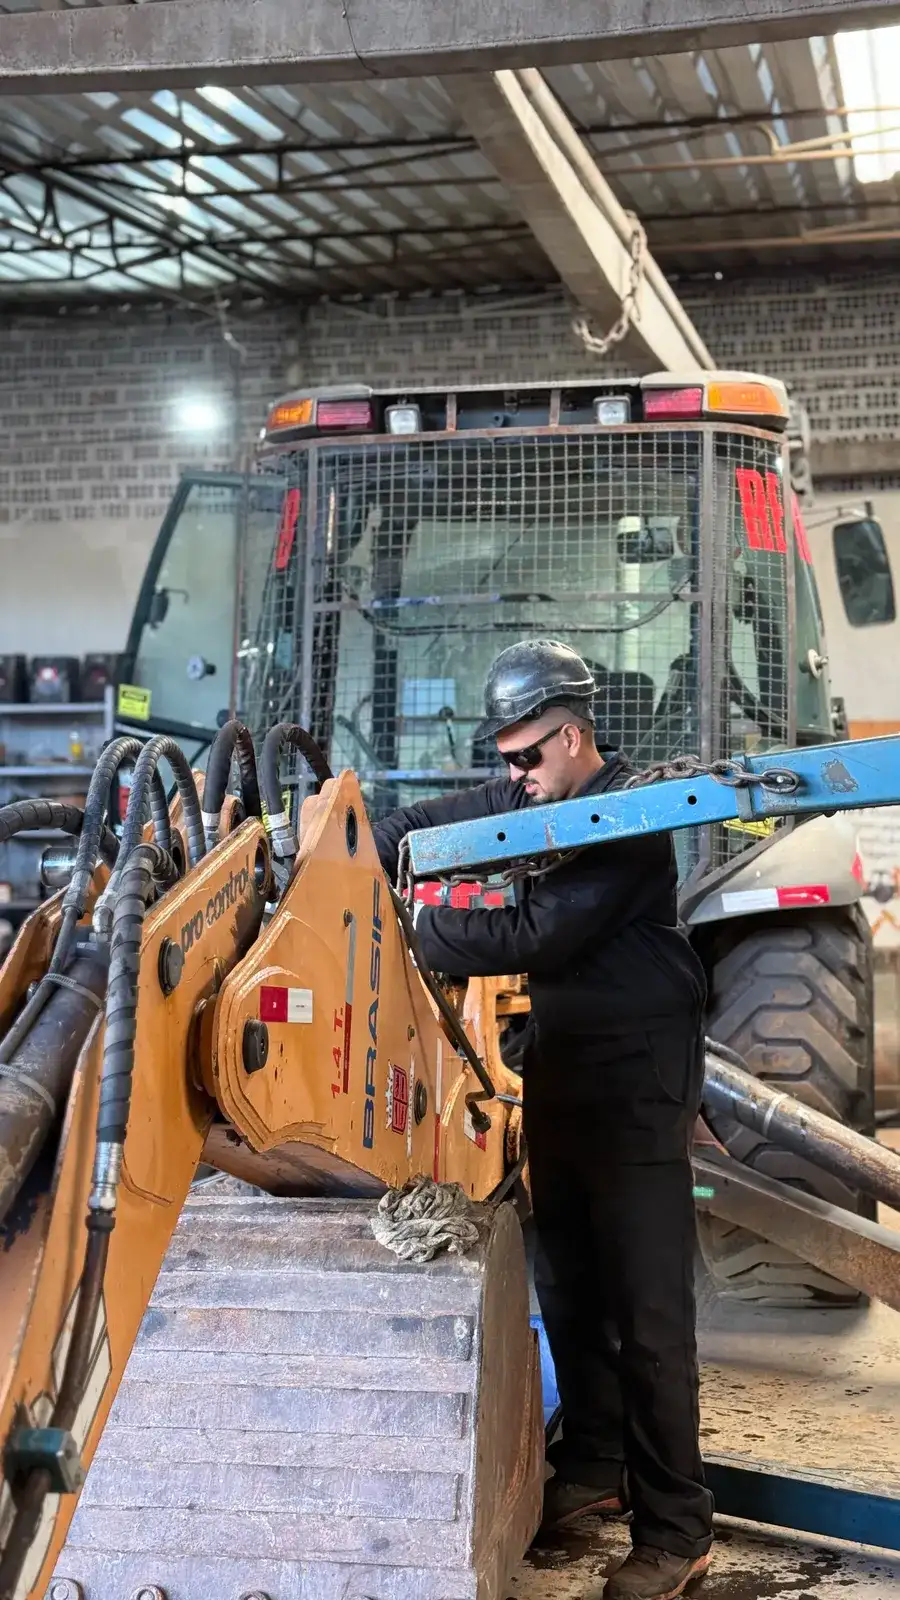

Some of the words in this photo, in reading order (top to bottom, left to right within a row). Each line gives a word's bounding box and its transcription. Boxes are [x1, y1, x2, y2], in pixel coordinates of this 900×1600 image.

[181, 909, 204, 954] pro
[205, 854, 249, 927] control
[362, 877, 383, 1149] BRASIF
